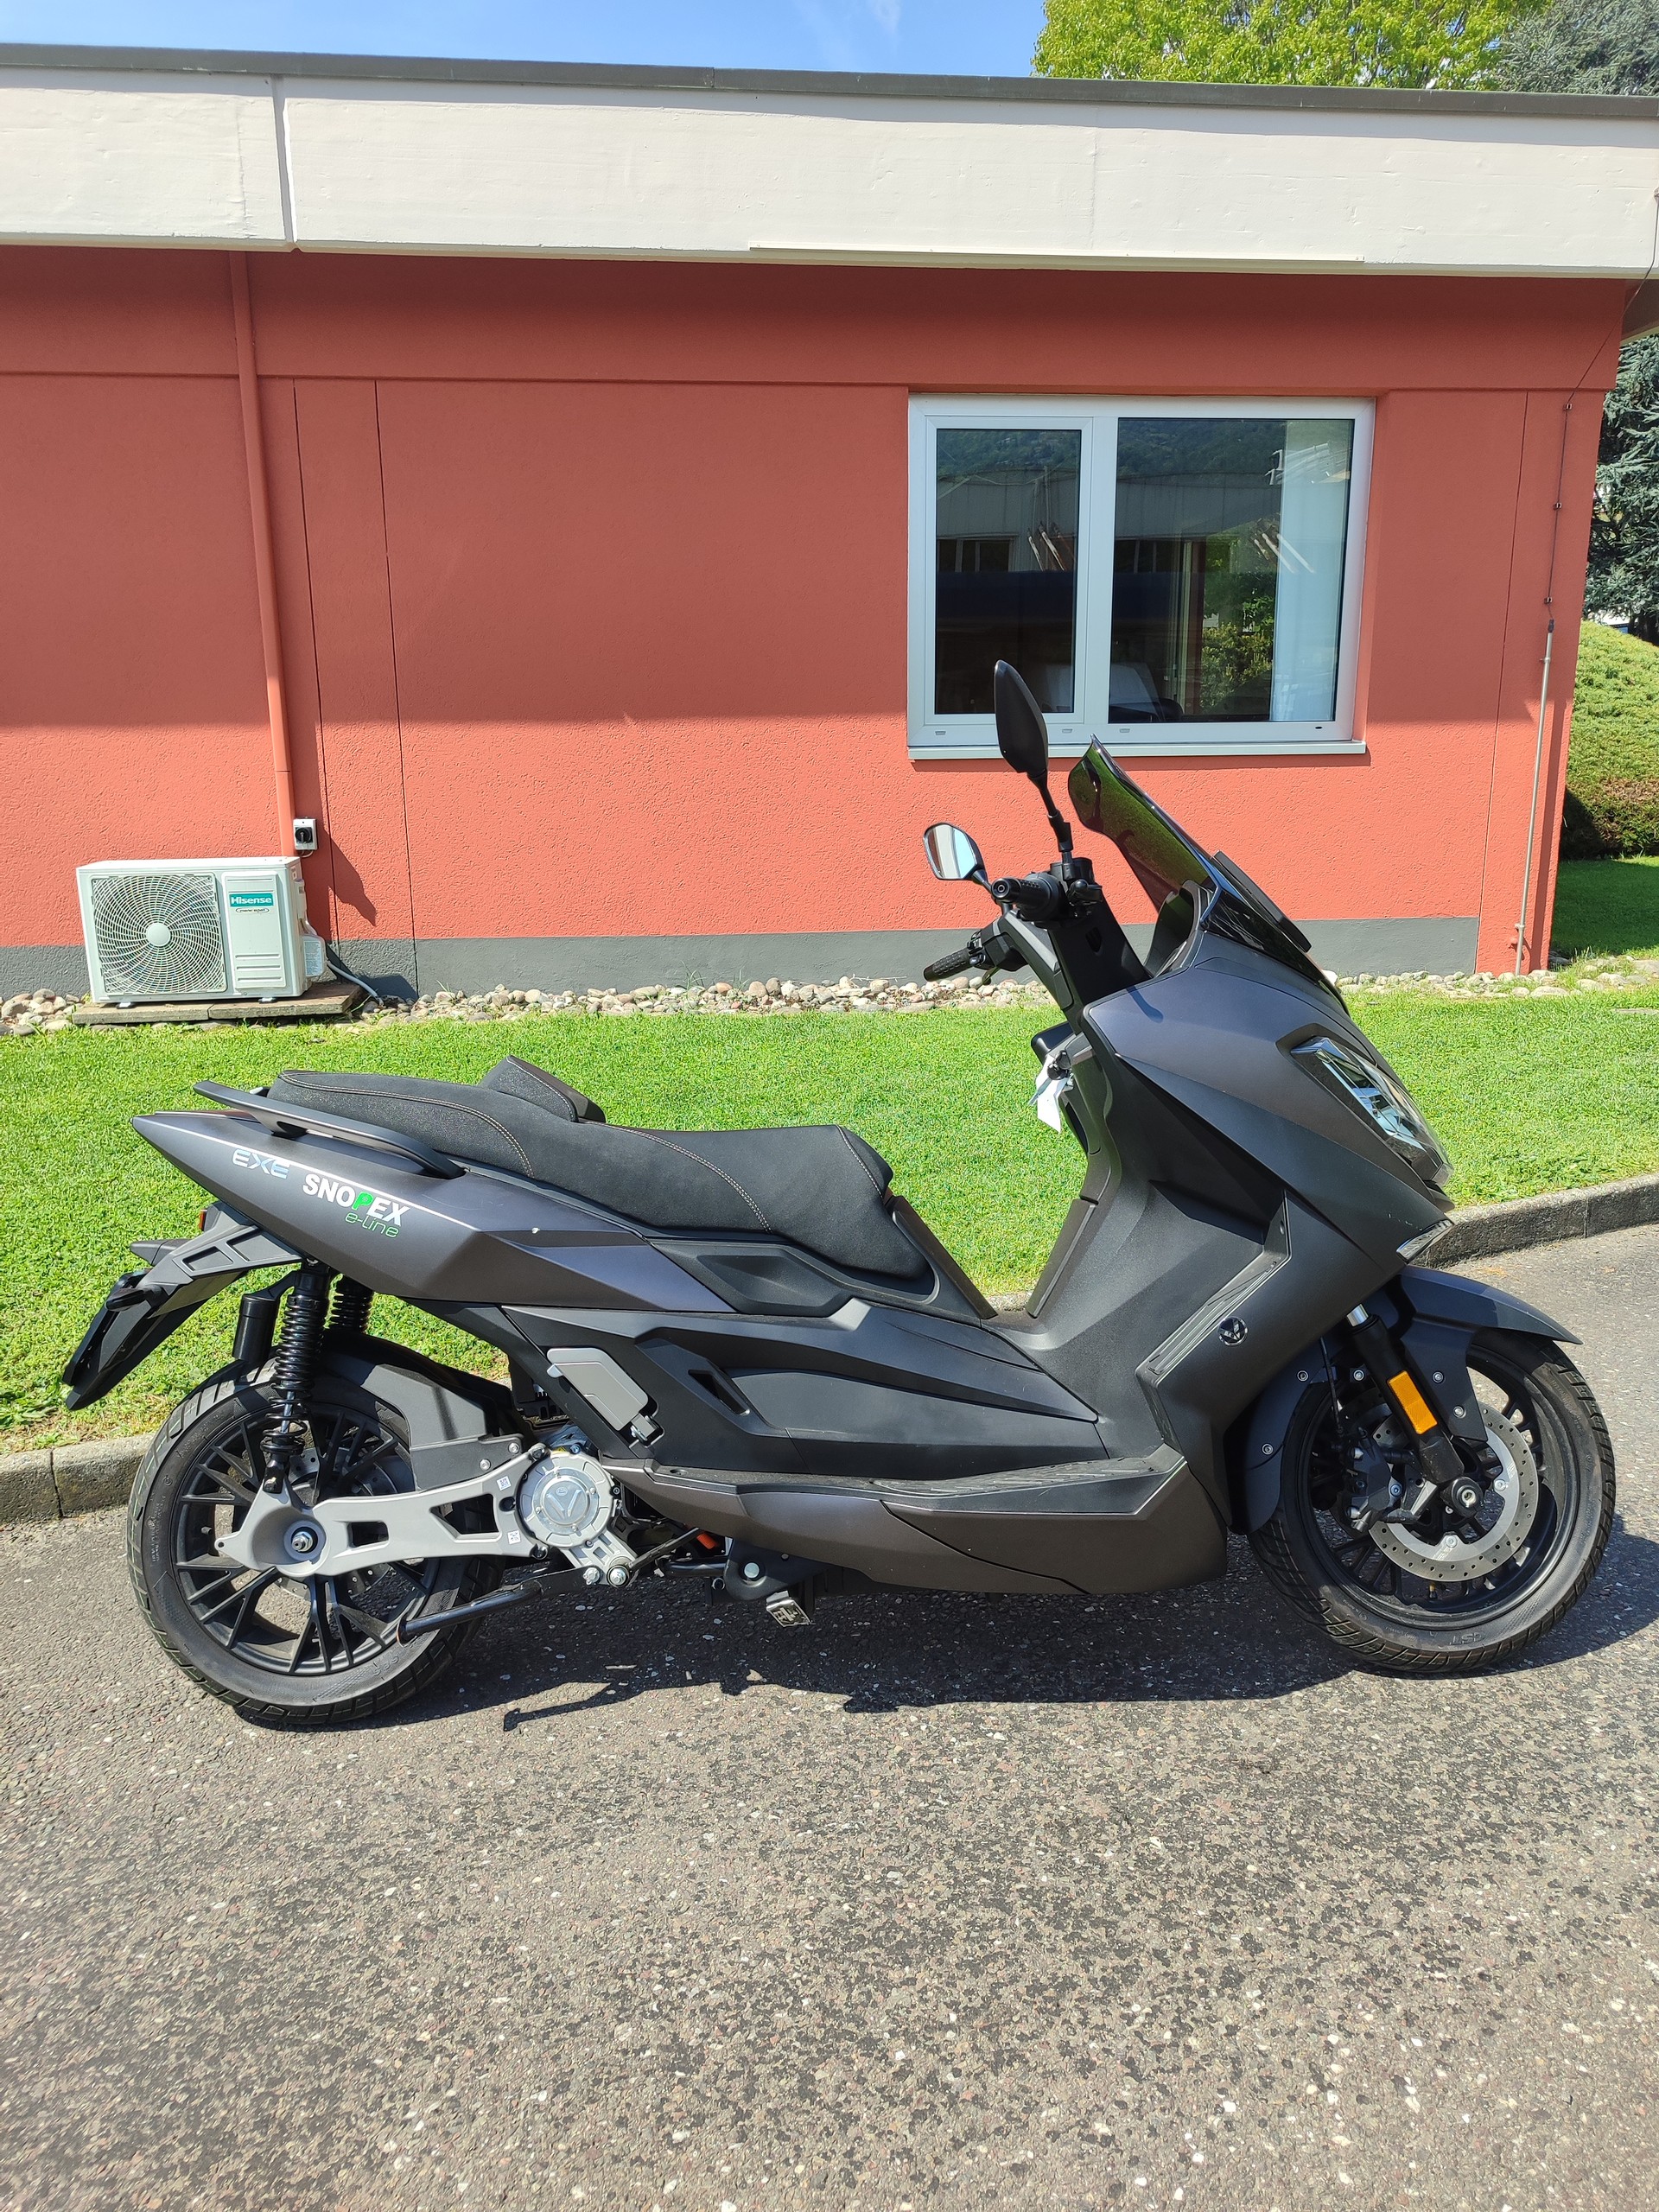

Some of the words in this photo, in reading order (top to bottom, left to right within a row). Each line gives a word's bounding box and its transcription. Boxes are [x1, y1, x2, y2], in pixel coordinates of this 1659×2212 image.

[231, 896, 272, 905] Hisense
[232, 1148, 290, 1179] EXE
[302, 1173, 410, 1227] SNOPEX
[345, 1211, 400, 1238] e-line
